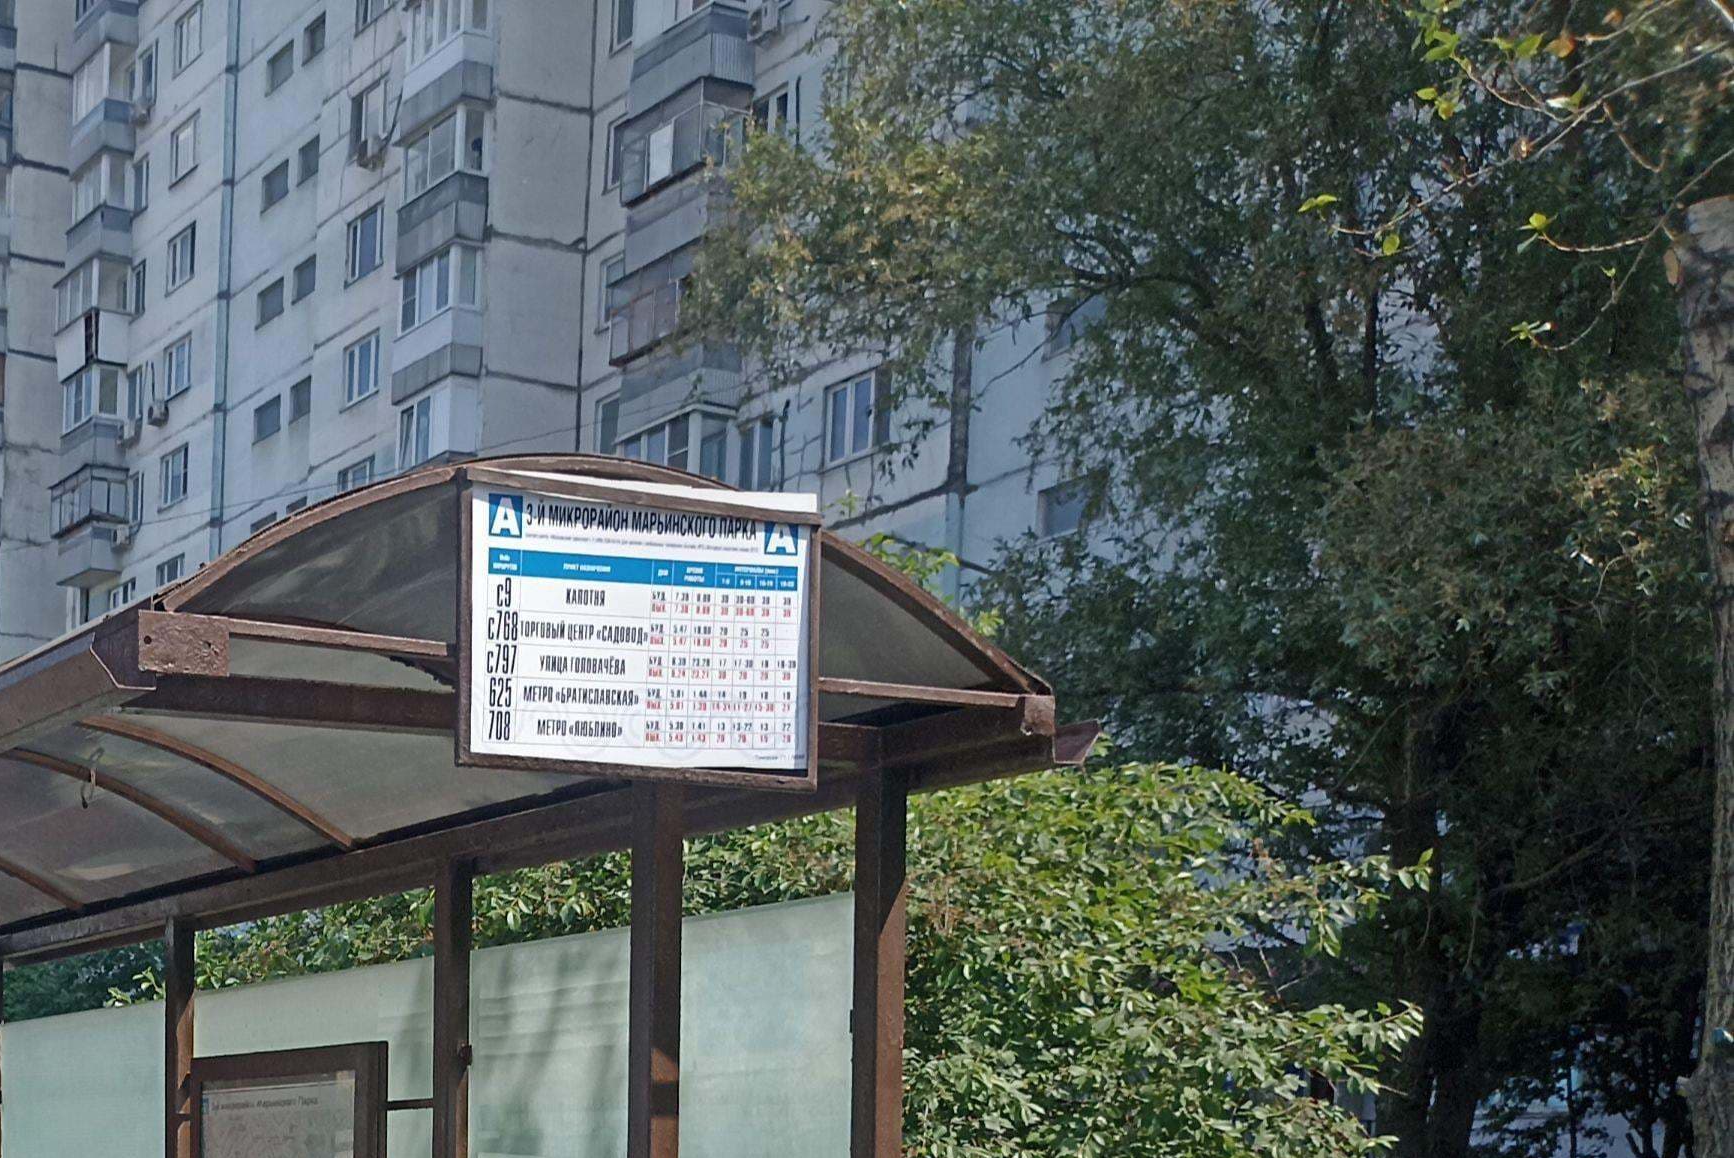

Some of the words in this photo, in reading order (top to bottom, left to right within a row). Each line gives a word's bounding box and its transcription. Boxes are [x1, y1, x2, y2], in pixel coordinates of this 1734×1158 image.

[526, 500, 545, 526] 3-Й
[548, 503, 628, 532] МИКРОРАЙОН
[631, 509, 716, 538] МАРЬИНСКОГО
[719, 515, 757, 540] ПАРКА
[497, 577, 512, 607] с9
[566, 588, 605, 606] КАПОТНЯ
[488, 610, 518, 641] с768
[520, 620, 565, 639] ТОРГОВЫЙ
[567, 624, 594, 642] ЦЕНТР
[596, 625, 648, 646] «САДОВОД»
[487, 644, 517, 674] с797
[540, 654, 568, 674] УЛИЦА
[570, 656, 626, 675] ГОЛОВАЧЁВА
[489, 677, 512, 708] 625
[523, 685, 554, 702] МЕТРО
[555, 687, 639, 707] «БРАТИСЛАВСКАЯ»
[488, 710, 511, 741] 708
[537, 719, 567, 736] МЕТРО
[568, 720, 623, 738] «ЛЮБЛИНО»
